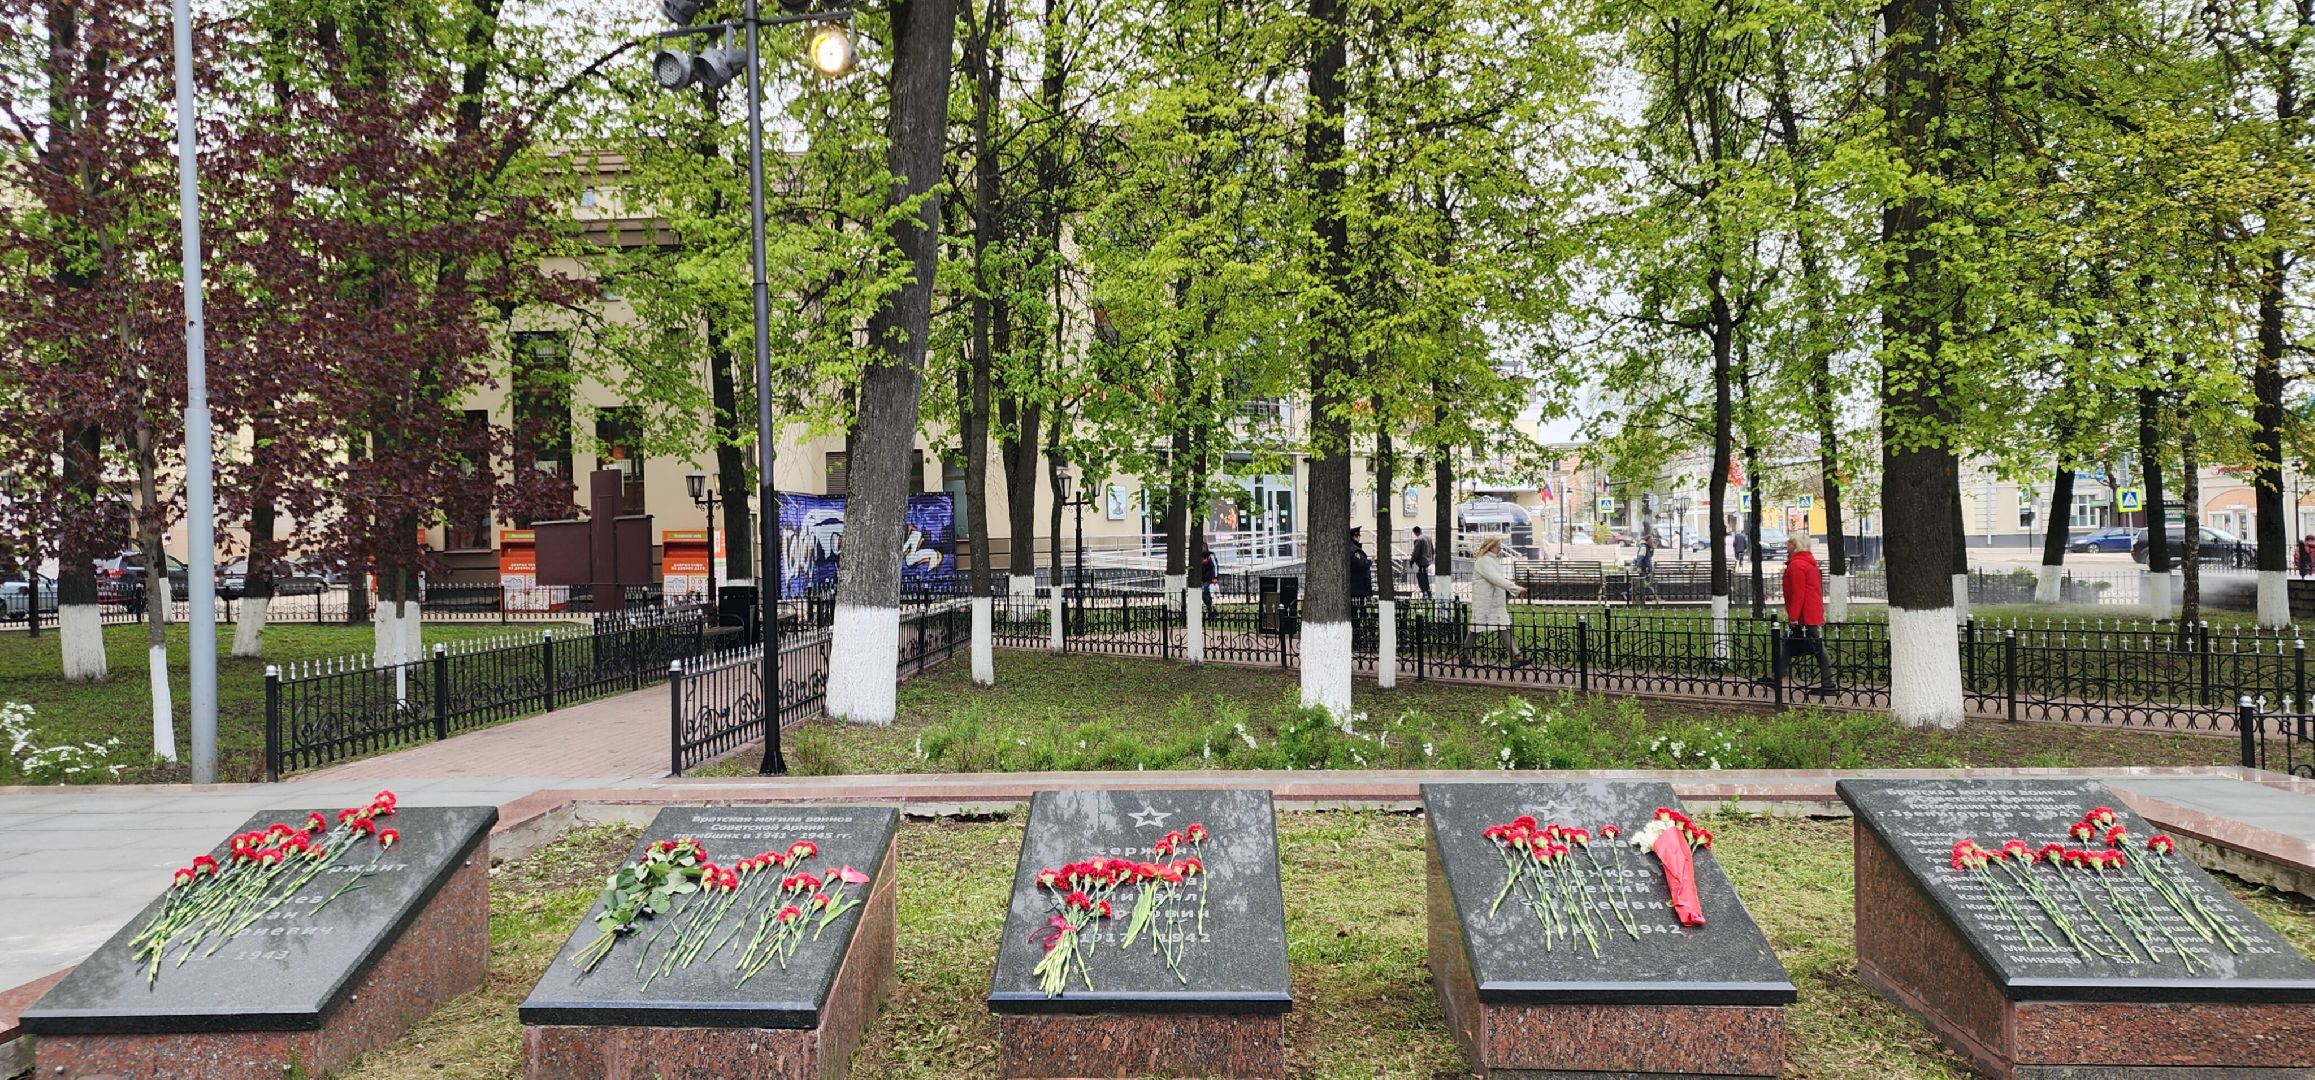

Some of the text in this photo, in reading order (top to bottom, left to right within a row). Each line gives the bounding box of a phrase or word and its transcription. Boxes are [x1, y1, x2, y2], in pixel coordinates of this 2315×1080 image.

[754, 815, 802, 823] могила
[805, 815, 852, 823] воинов
[710, 823, 825, 832] Советской Армии
[234, 950, 290, 960] 1943
